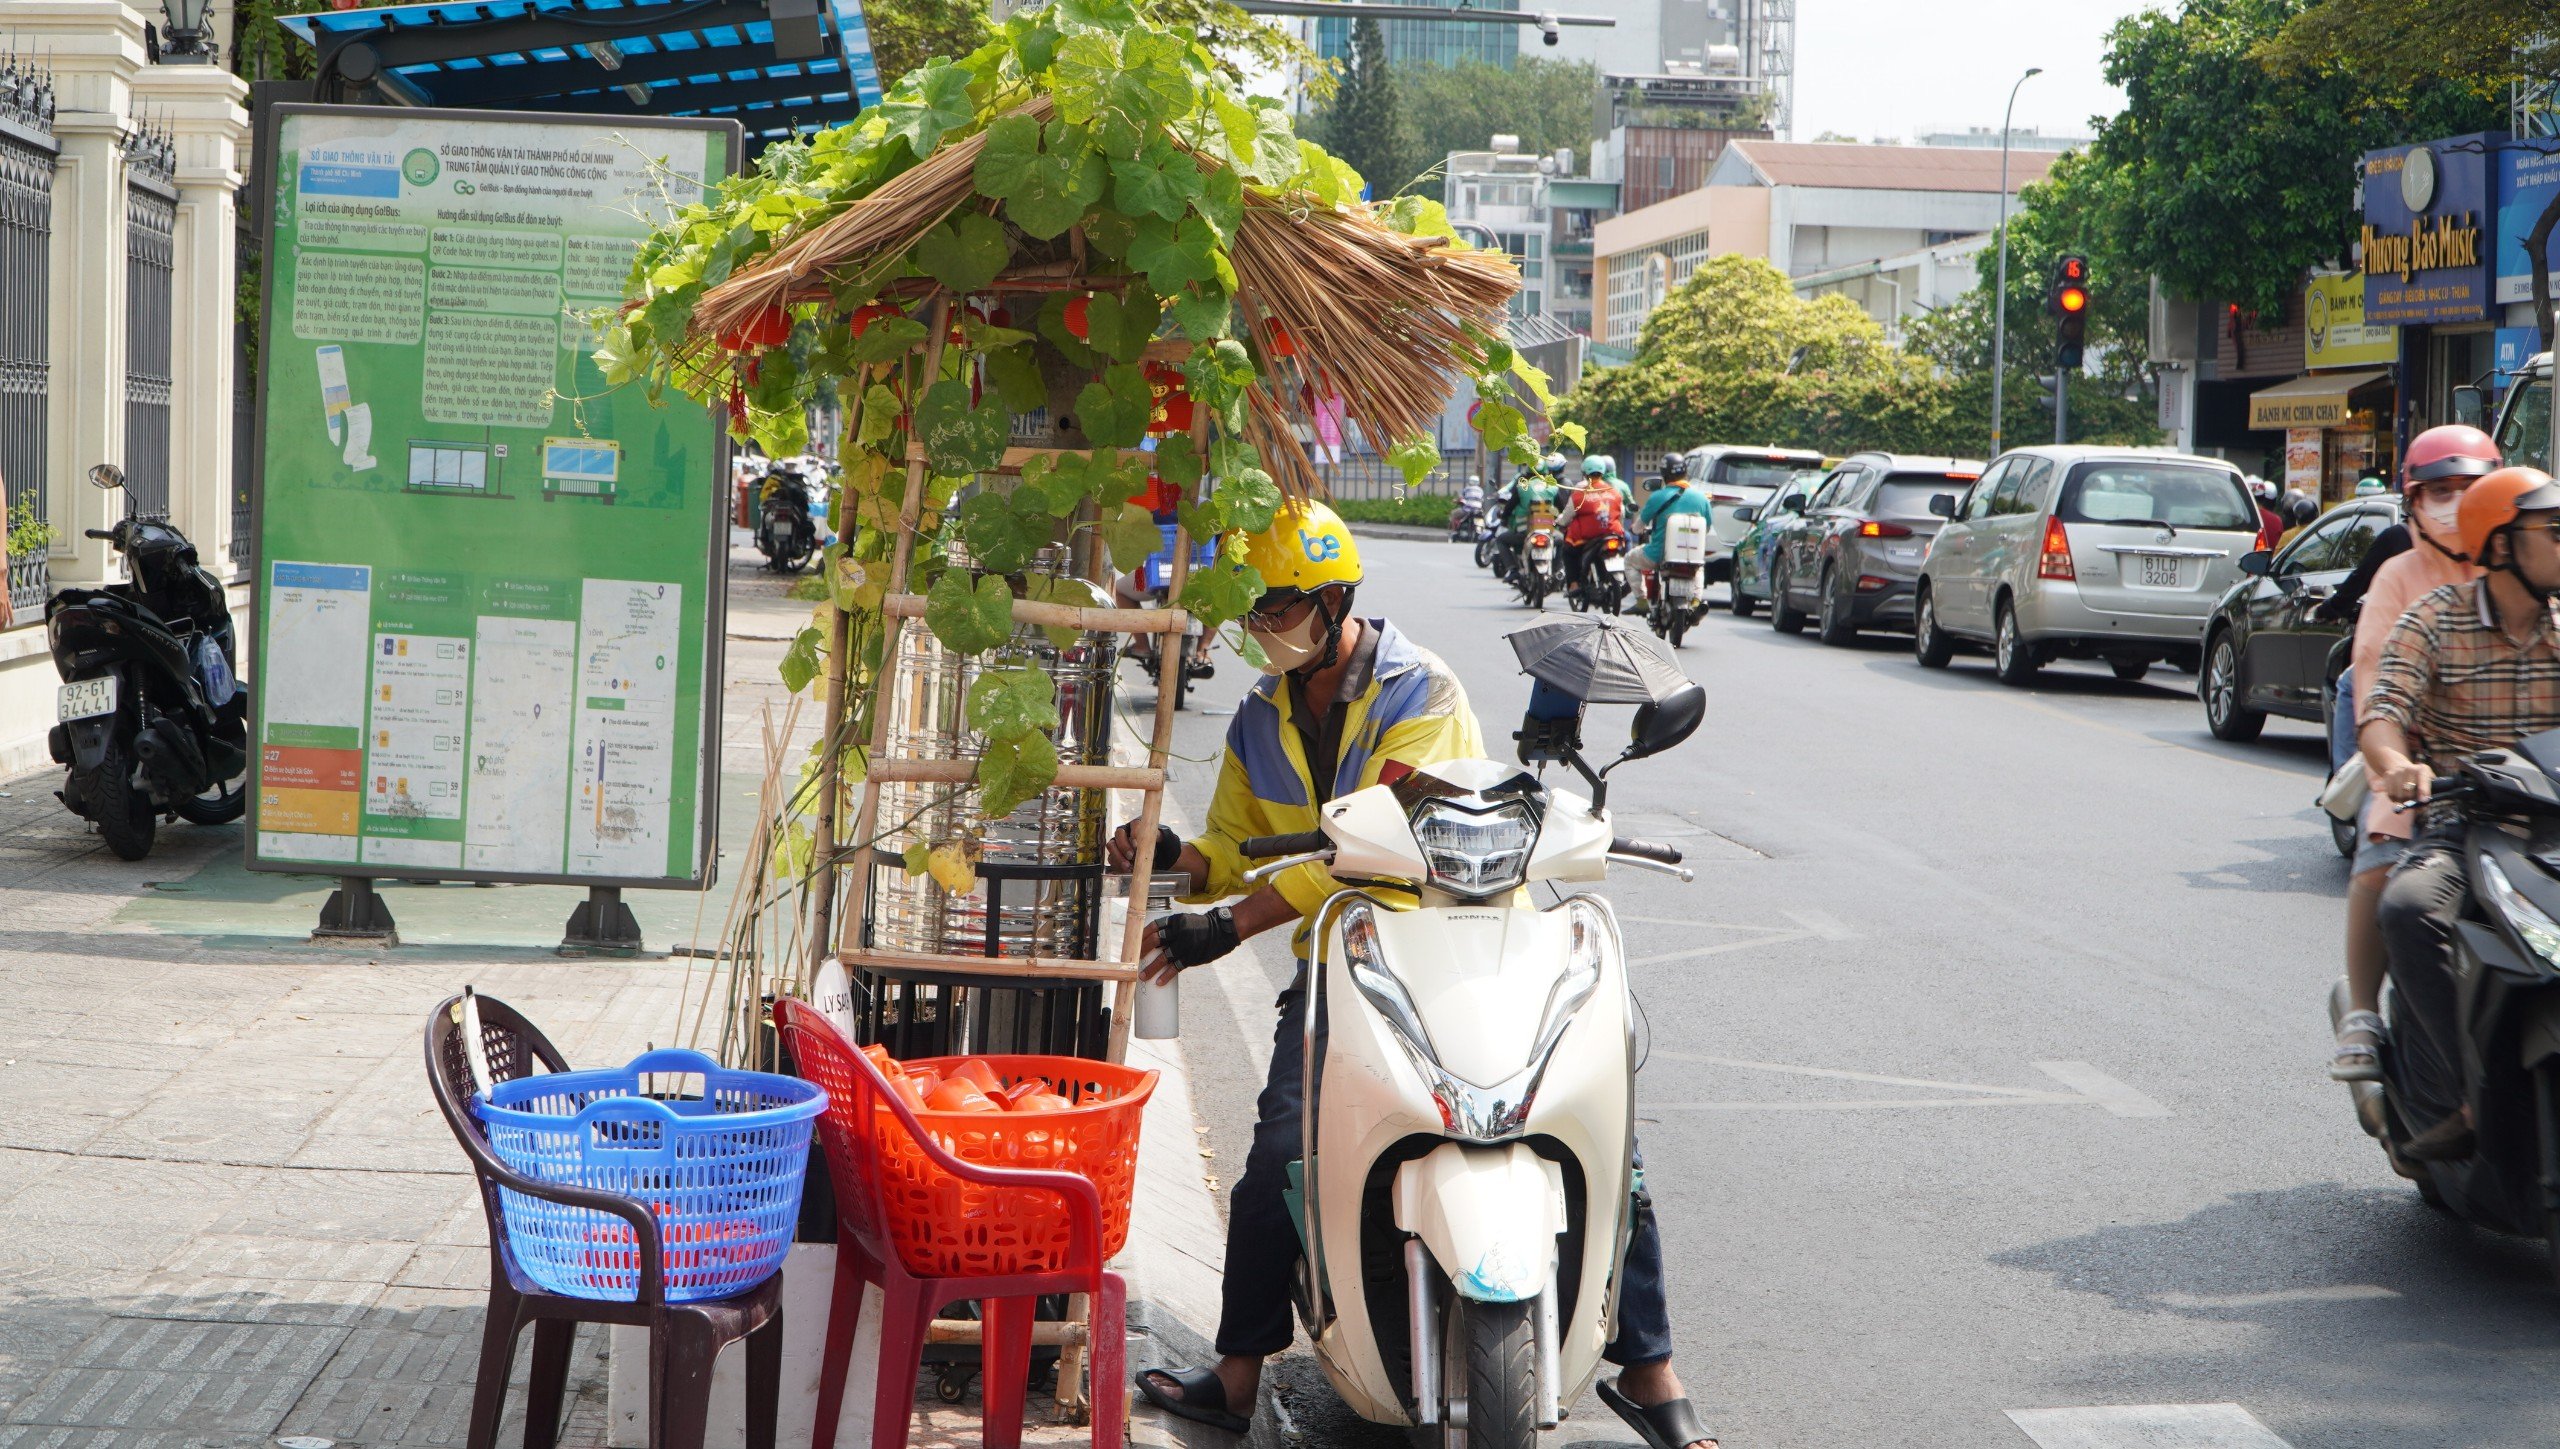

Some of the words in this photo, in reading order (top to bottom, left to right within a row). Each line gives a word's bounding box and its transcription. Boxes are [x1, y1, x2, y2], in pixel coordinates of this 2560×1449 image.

[441, 143, 449, 155] SỞ
[451, 146, 468, 156] GIAO
[471, 145, 494, 158] THÔNG
[497, 146, 511, 160] VẬN
[514, 147, 524, 160] TẢI
[527, 148, 550, 161] THÀNH
[553, 148, 567, 162] PHỐ
[569, 149, 578, 162] HỒ
[581, 151, 592, 163] CHÍ
[594, 154, 613, 164] MINH
[446, 162, 469, 172] TRUNG
[471, 161, 486, 173] TÂM
[489, 162, 508, 176] QUẢN
[511, 163, 518, 175] LÝ
[521, 166, 538, 176] GIAO
[540, 164, 564, 177] THÔNG
[566, 166, 585, 179] CÔNG
[587, 167, 606, 181] CỘNG
[454, 180, 475, 195] Go
[306, 203, 315, 214] Lợi
[316, 204, 326, 213] ích
[328, 204, 339, 213] của
[341, 205, 354, 216] ứng
[355, 206, 372, 217] dụng
[374, 206, 400, 216] Go!Bus:
[438, 210, 456, 221] Hướng
[458, 210, 468, 220] dẫn
[470, 212, 477, 220] sử
[478, 212, 493, 223] dụng
[494, 213, 515, 222] Go!Bus
[516, 213, 524, 223] để
[525, 214, 536, 224] đón
[547, 216, 562, 227] buýt:
[2362, 224, 2409, 283] Phương
[2412, 216, 2437, 271] Bảo
[2439, 210, 2477, 268] Music
[2514, 282, 2532, 294] EXIMB
[2501, 343, 2515, 360] ATM
[2294, 405, 2314, 420] CHIM
[2316, 404, 2340, 423] CHẠY
[1298, 529, 1340, 562] be
[2146, 572, 2176, 585] 3206
[458, 644, 465, 652] 46
[67, 681, 105, 701] 92-G1
[62, 696, 110, 719] 344.41
[453, 736, 460, 744] 52
[270, 751, 279, 760] 27
[451, 782, 458, 790] 59
[824, 995, 834, 1014] LY
